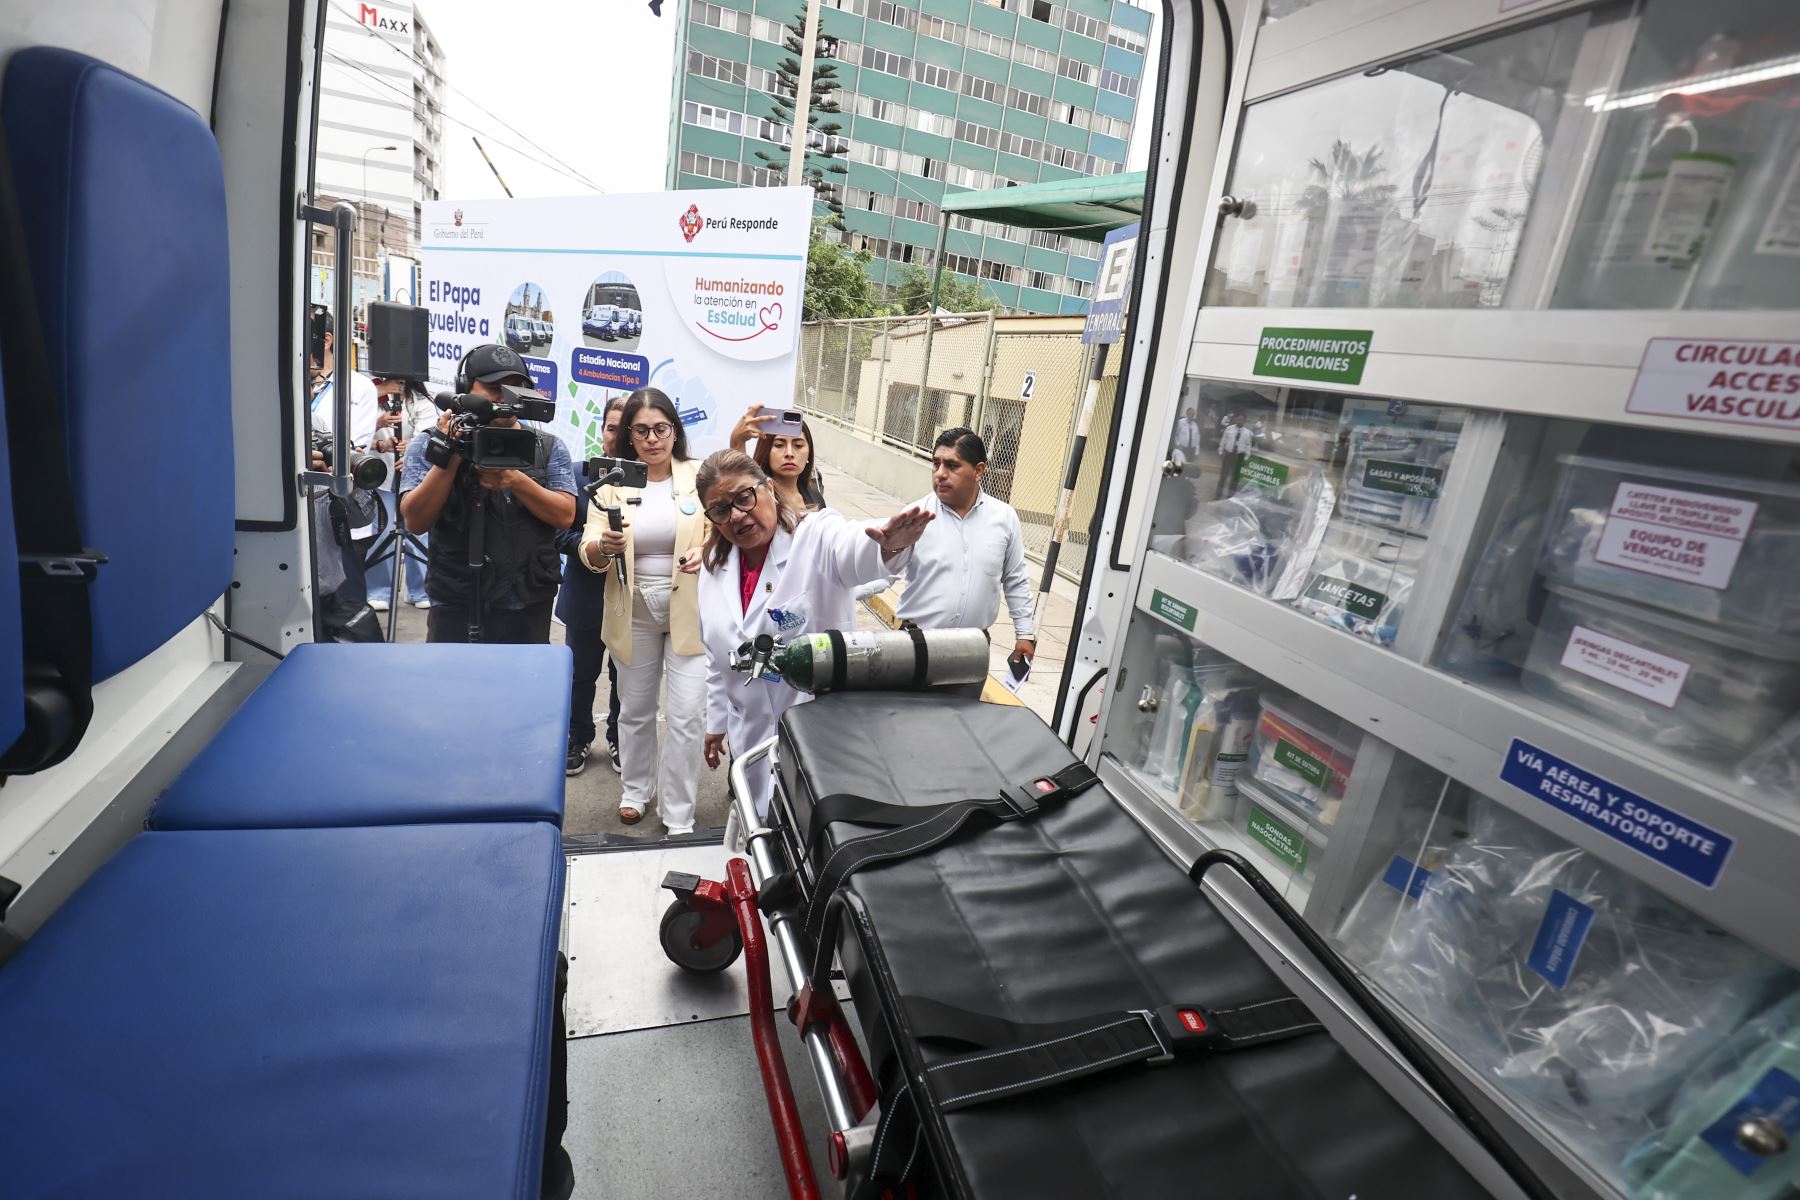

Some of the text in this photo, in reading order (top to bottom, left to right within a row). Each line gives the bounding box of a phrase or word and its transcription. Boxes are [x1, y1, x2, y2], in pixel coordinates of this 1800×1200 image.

[359, 2, 408, 34] MAXX
[433, 228, 484, 239] Gobierno del Perú
[706, 217, 779, 233] Perú Responde
[1104, 248, 1128, 294] E
[429, 280, 481, 312] El Papa
[695, 277, 785, 297] Humanizando
[694, 294, 757, 309] la atención en
[428, 311, 489, 336] vuelve a
[707, 309, 757, 328] EsSalud
[1085, 311, 1122, 332] TEMPORAL
[429, 340, 462, 361] casa
[1261, 337, 1367, 355] PROCEDIMIENTOS
[529, 362, 551, 374] Armas
[579, 353, 641, 372] Estadio Nacional
[1273, 354, 1350, 372] CURACIONES
[1022, 375, 1034, 398] 2
[1240, 467, 1281, 487] DESCARTABLES
[1368, 468, 1393, 480] GASAS
[1394, 471, 1400, 480] Y
[1629, 528, 1707, 553] EQUIPO DE
[1622, 541, 1706, 568] VENOCLISIS
[1317, 581, 1377, 608] LANCETAS
[1517, 750, 1717, 856] VÍA AÉREA Y SOPORTE
[1539, 778, 1670, 852] RESPIRATORIO
[1265, 823, 1292, 846] SONDAS
